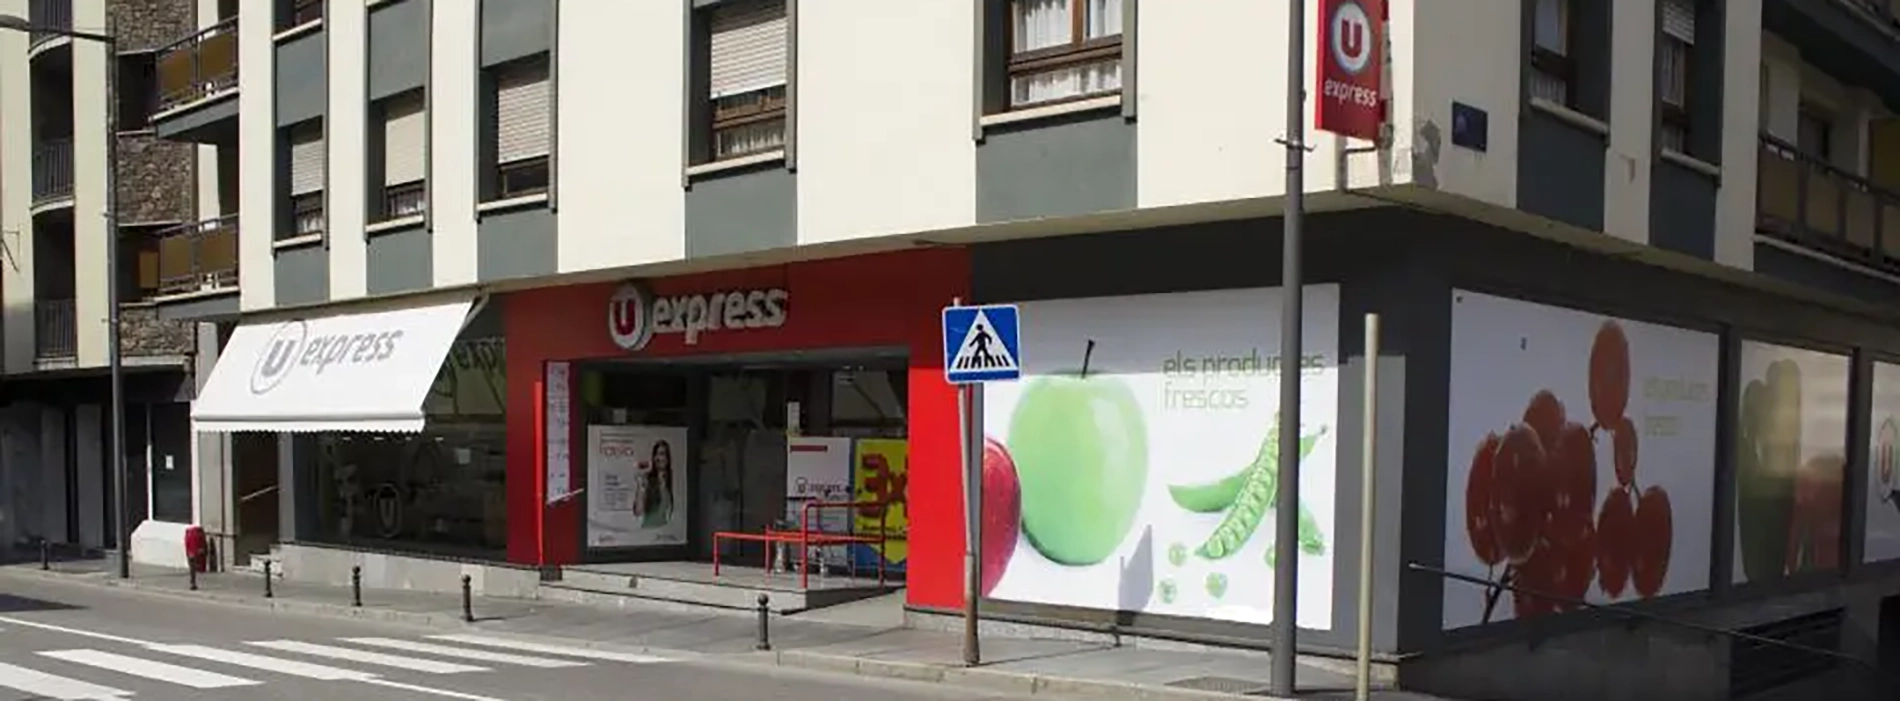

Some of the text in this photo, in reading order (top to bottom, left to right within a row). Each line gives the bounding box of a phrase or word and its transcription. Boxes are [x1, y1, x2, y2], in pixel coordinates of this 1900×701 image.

[1341, 18, 1362, 58] U
[1324, 78, 1377, 107] express
[652, 288, 788, 345] express
[300, 329, 404, 375] express
[1164, 348, 1325, 384] els produces
[1166, 382, 1249, 408] frescos
